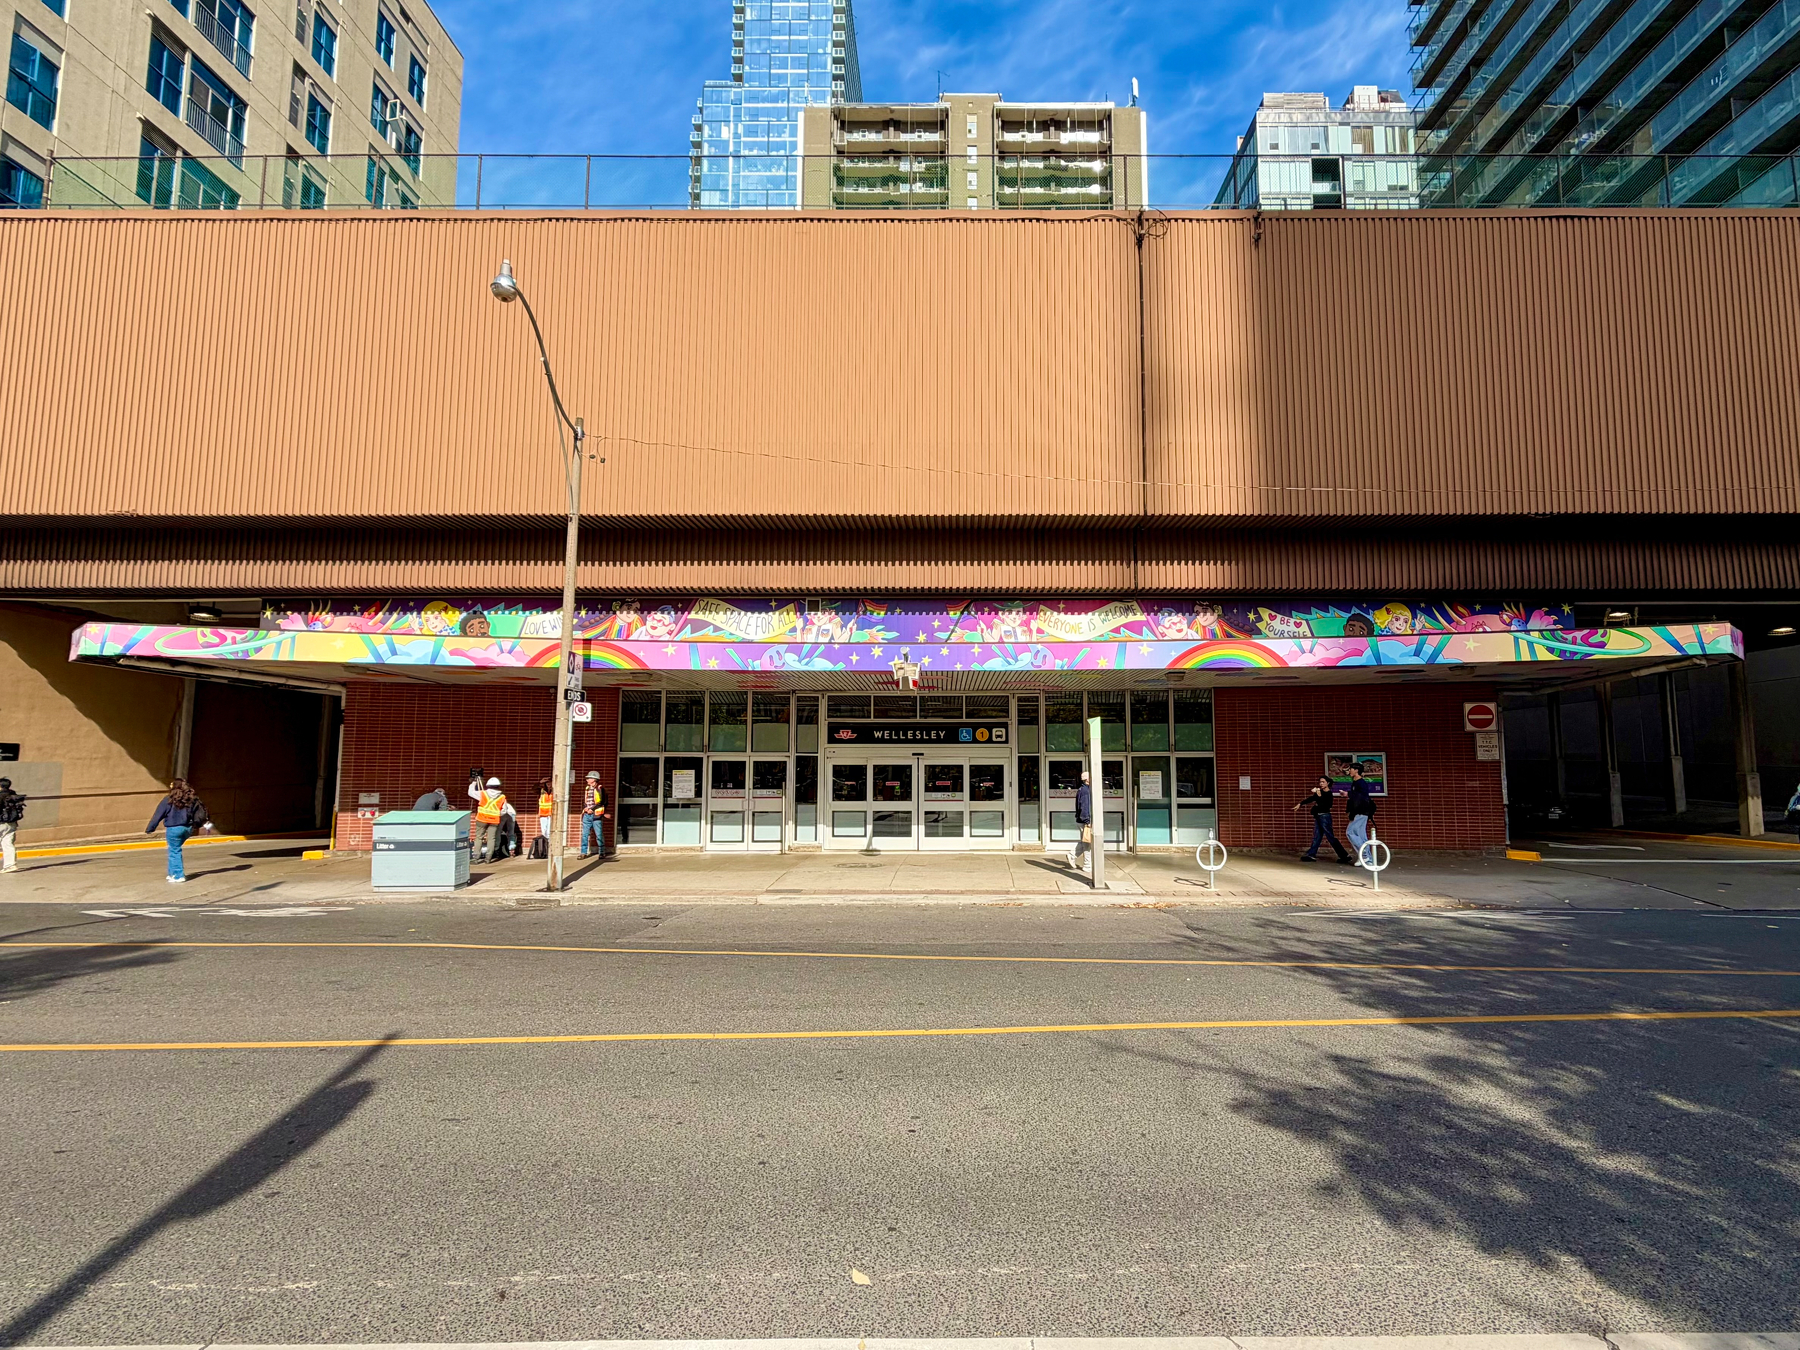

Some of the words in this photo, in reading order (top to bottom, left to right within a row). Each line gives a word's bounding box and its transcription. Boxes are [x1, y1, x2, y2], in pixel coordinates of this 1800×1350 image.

[695, 598, 721, 622] SAFE
[720, 607, 753, 636] SPACE
[755, 614, 775, 636] FOR
[778, 608, 796, 630] ALL
[1038, 609, 1084, 635] EVERYONE
[1088, 618, 1096, 632] IS
[1099, 604, 1138, 625] WELCOME
[1279, 616, 1292, 627] BE
[524, 620, 549, 635] LOVE
[1264, 621, 1308, 638] YOURSELF
[873, 730, 946, 739] WELLESLEY
